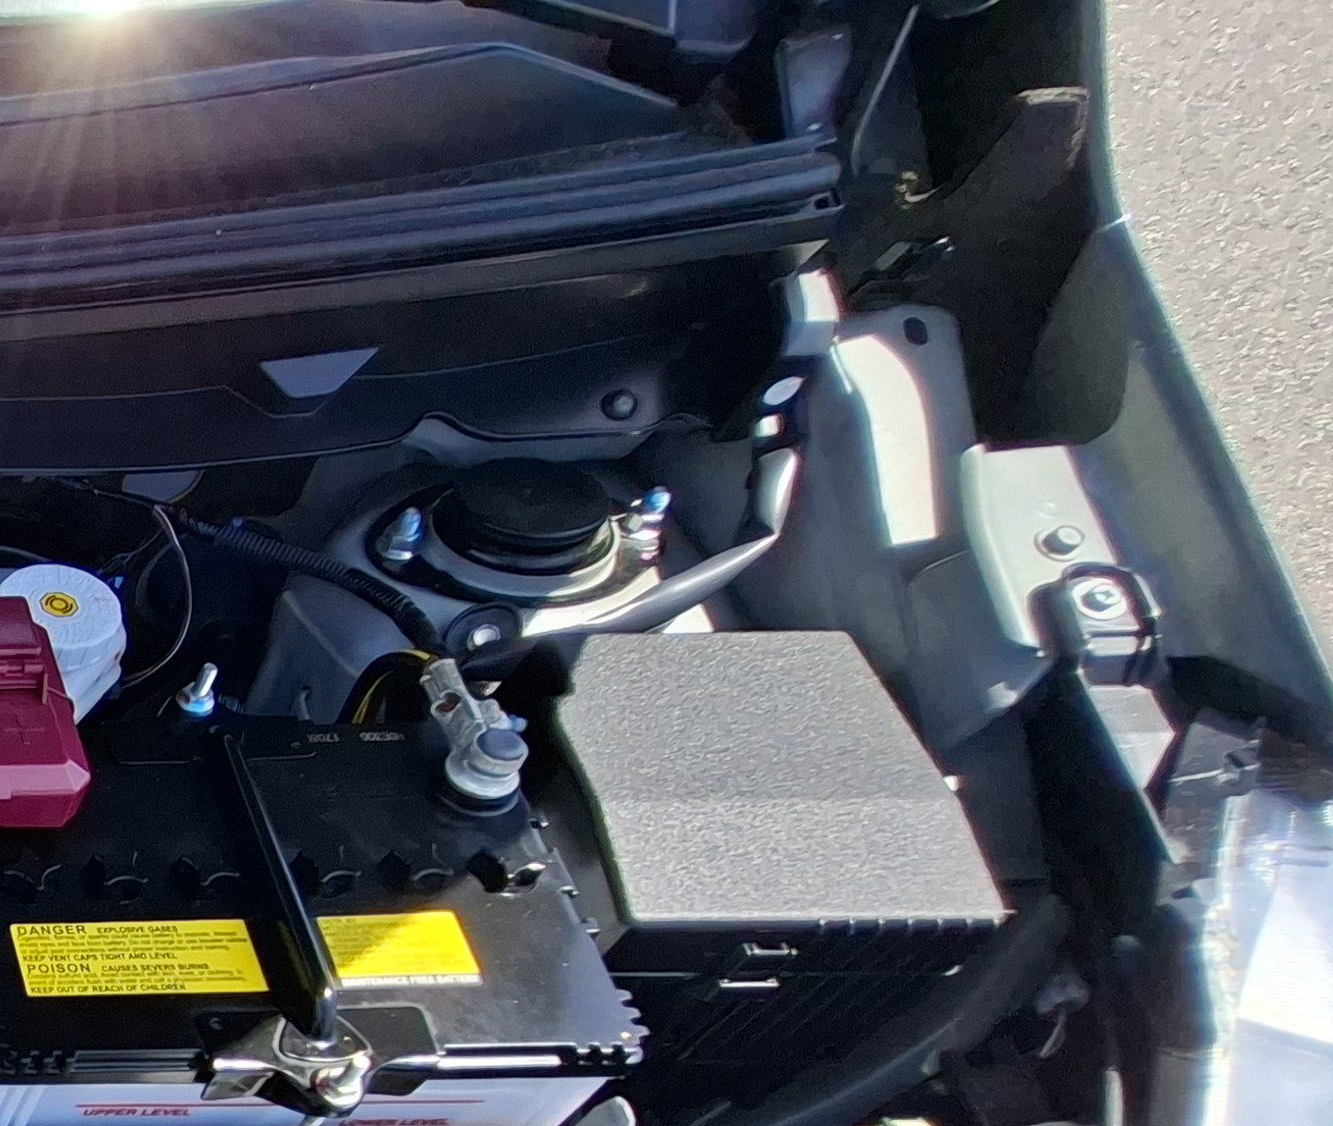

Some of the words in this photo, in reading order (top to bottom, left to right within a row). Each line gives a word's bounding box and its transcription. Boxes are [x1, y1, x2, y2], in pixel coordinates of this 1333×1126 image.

[17, 925, 87, 936] DANGER
[96, 926, 144, 934] EXPLOSIVE
[148, 925, 178, 933] GASES
[48, 954, 70, 962] VENT
[27, 963, 91, 973] POISON
[101, 964, 138, 972] CAUSES
[31, 986, 54, 994] KEEP
[78, 985, 89, 993] OF
[140, 983, 186, 991] CHILDREN
[83, 1109, 138, 1117] UPPER
[140, 1109, 190, 1117] LEVEL
[338, 1118, 398, 1126] LOWER
[399, 1118, 449, 1126] LEVEL
